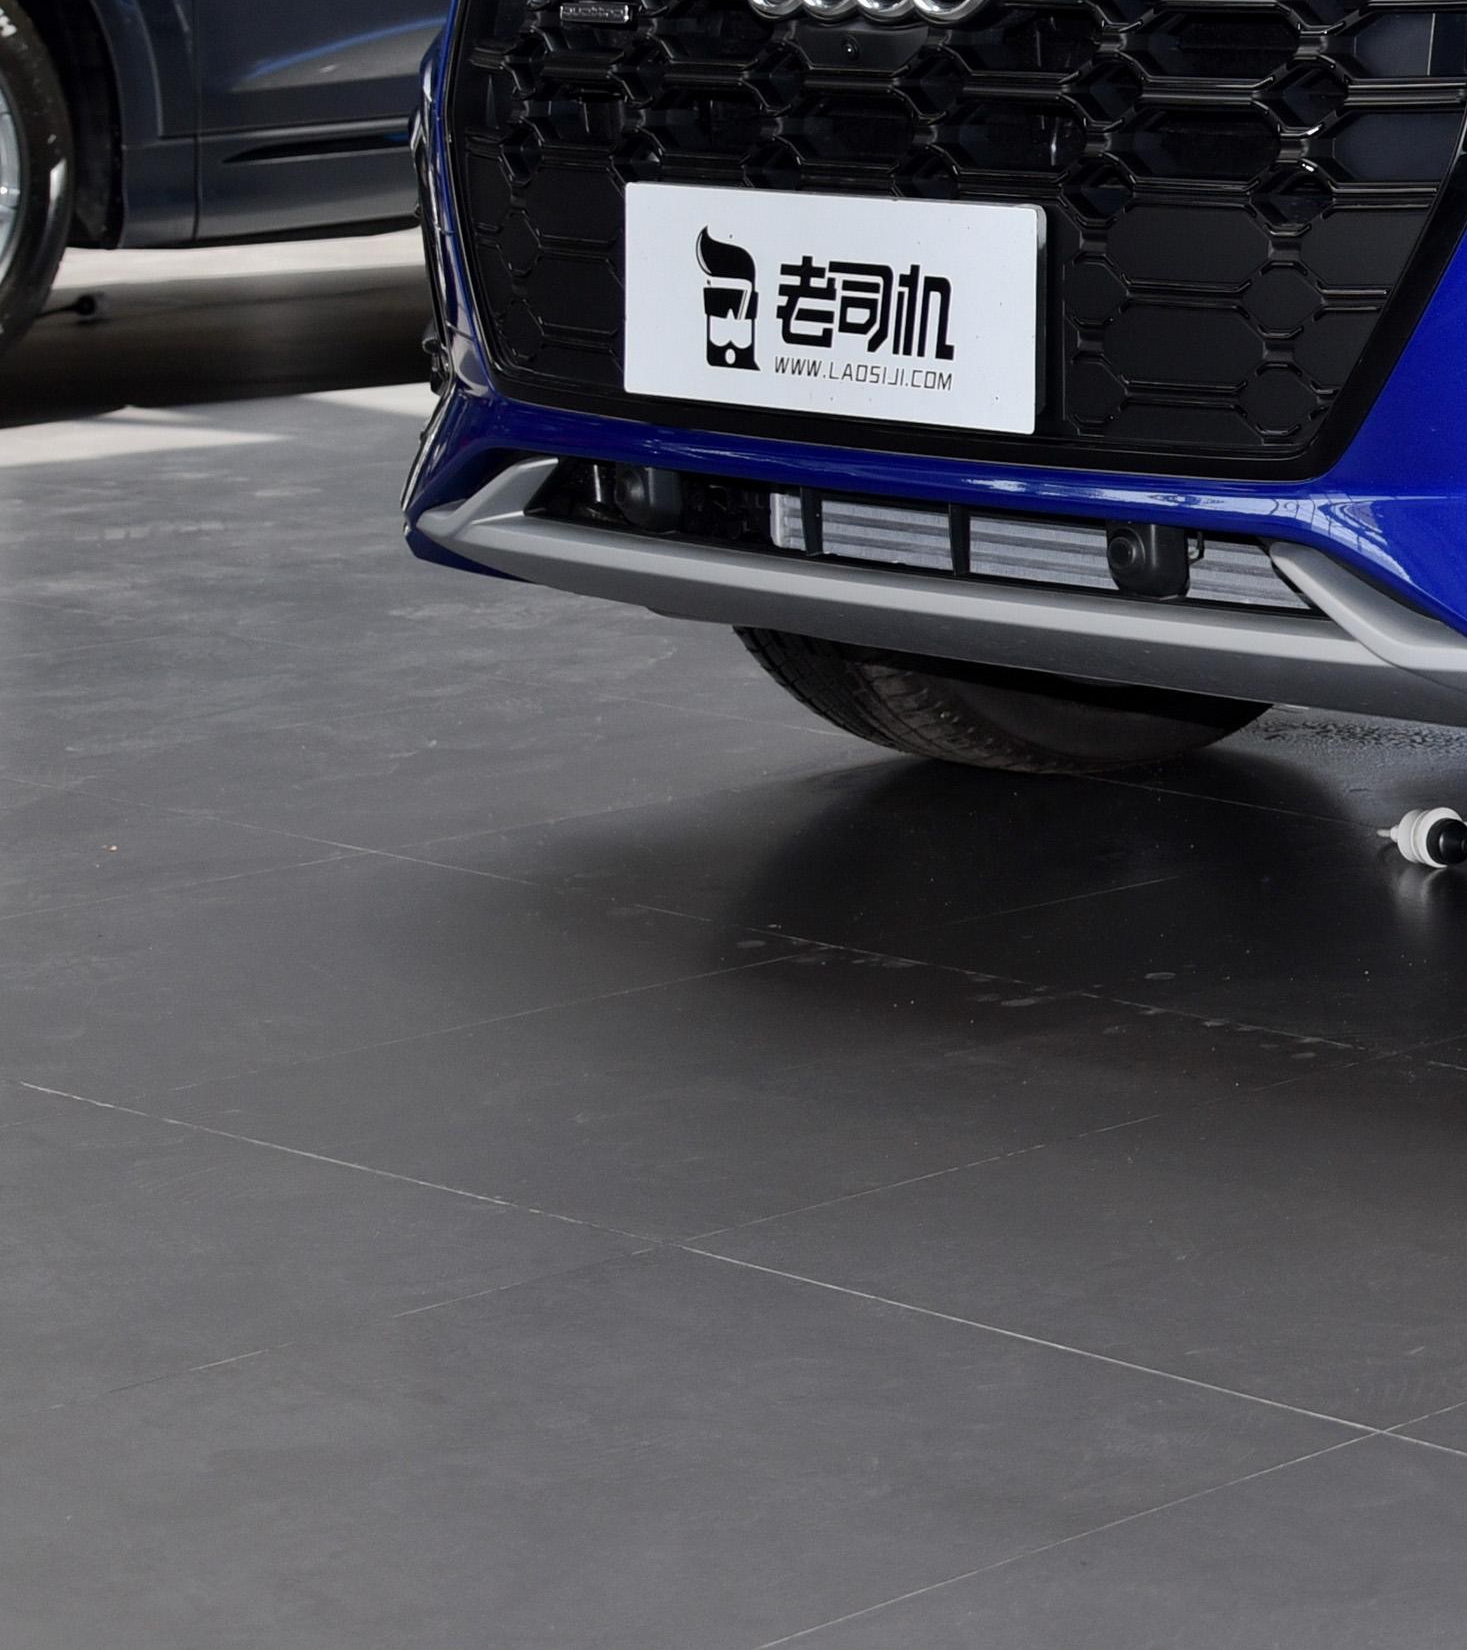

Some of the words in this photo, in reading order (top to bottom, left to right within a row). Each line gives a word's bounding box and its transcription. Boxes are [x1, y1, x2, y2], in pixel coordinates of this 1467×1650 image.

[776, 255, 955, 361] 老司机
[774, 355, 953, 391] WWW.LAOSIJI.COM
